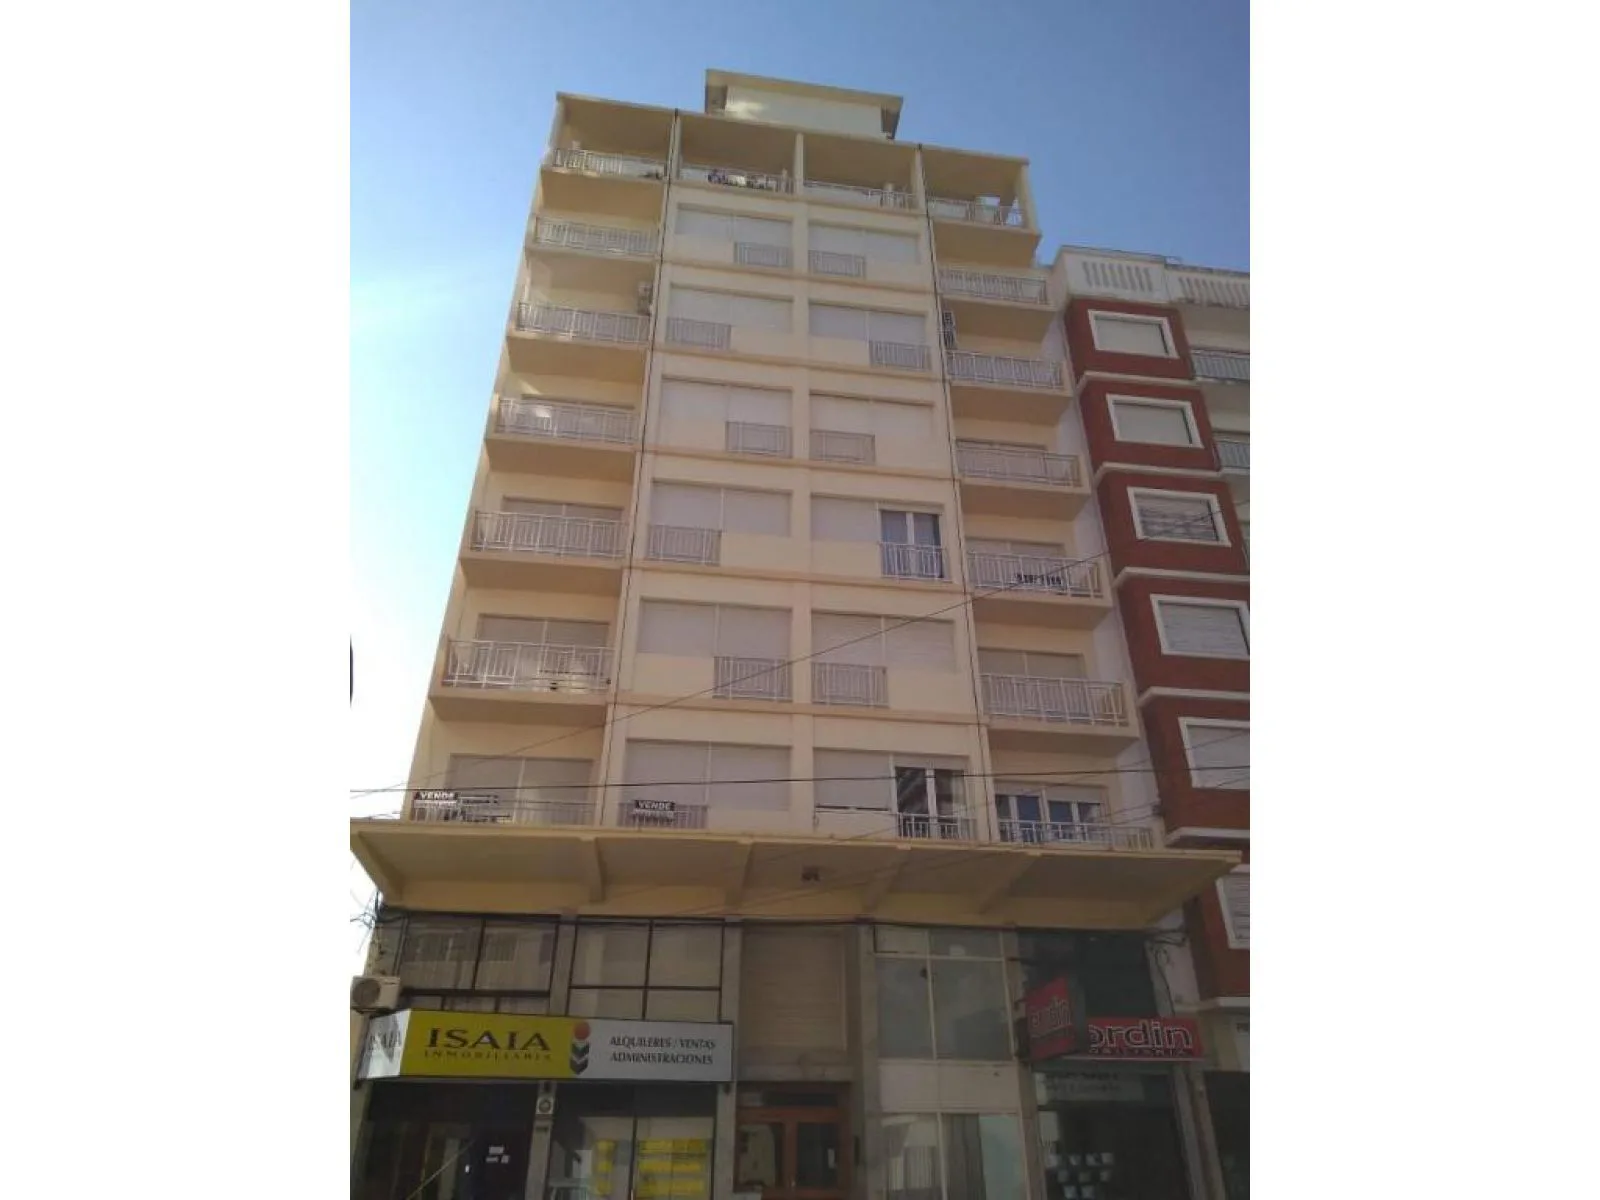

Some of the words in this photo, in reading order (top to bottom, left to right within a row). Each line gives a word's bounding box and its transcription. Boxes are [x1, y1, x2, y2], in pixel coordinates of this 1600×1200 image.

[424, 1027, 551, 1051] ISAIA
[609, 1035, 672, 1049] ALQUILERES
[679, 1037, 716, 1050] VENTAS
[610, 1050, 713, 1065] ADMINISTRACIONES
